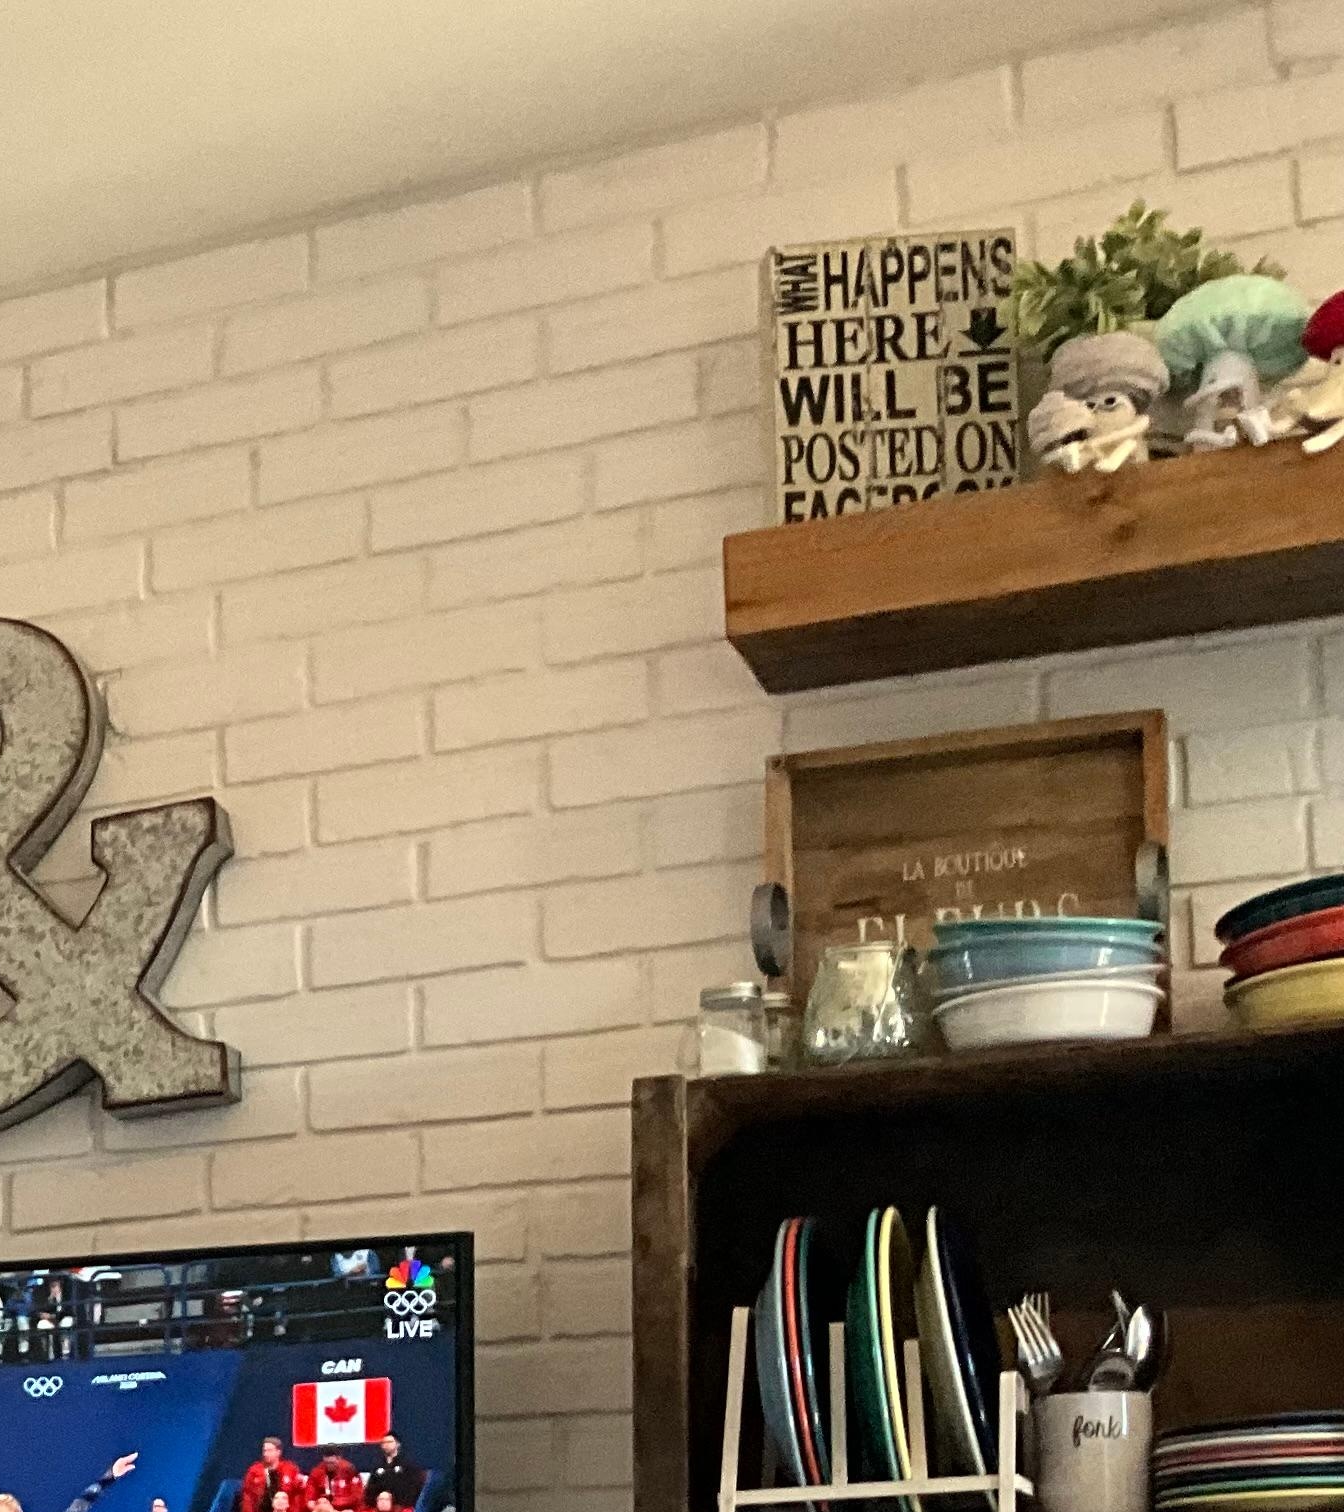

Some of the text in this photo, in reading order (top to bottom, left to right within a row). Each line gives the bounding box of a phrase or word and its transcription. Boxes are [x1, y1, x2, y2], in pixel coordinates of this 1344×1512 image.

[775, 237, 1013, 315] WHAT HAPPENS
[782, 310, 951, 370] HERE
[780, 362, 1012, 427] WILL BE
[781, 420, 1018, 486] POSTED ON
[386, 1319, 434, 1339] LIVE
[321, 1358, 363, 1375] CAN
